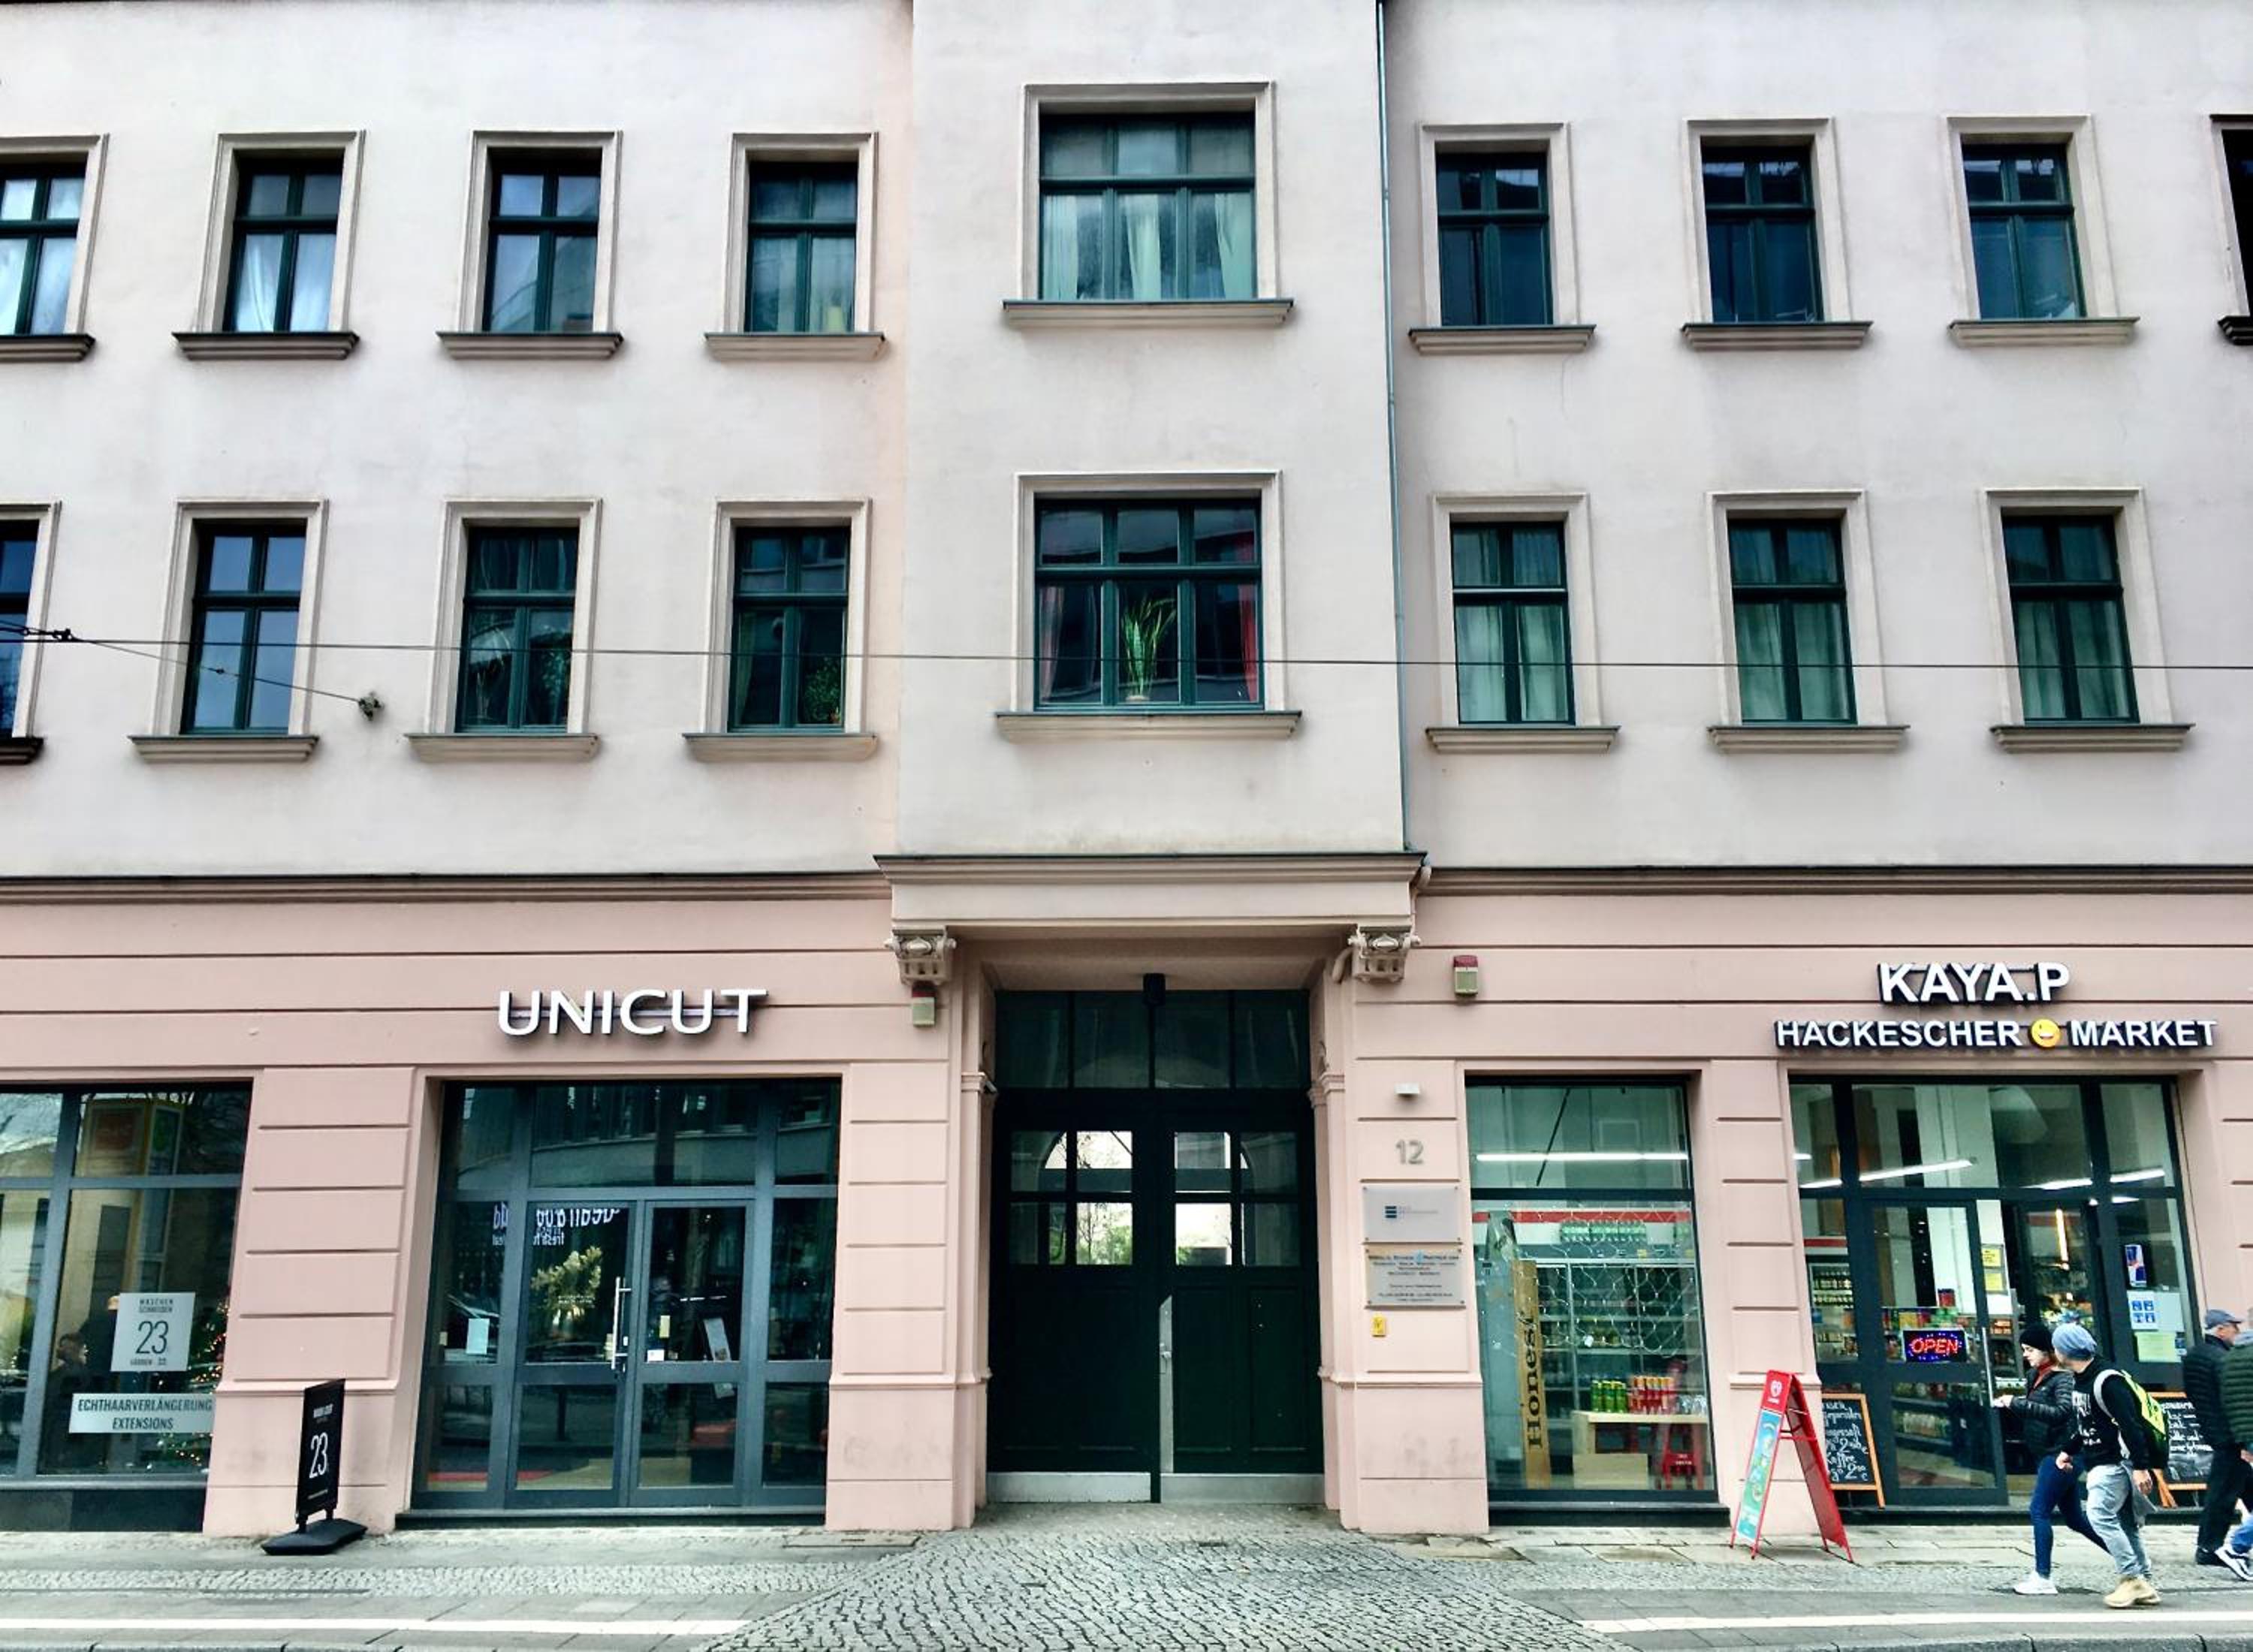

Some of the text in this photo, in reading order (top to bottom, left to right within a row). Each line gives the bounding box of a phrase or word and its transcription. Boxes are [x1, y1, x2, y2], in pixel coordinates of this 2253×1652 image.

[1878, 961, 2070, 1004] KAYA.P
[498, 987, 768, 1036] UNICUT
[1775, 1019, 2218, 1048] HACKESCHER MARKET
[1395, 1138, 1425, 1165] 12
[135, 1320, 169, 1355] 23
[1910, 1337, 1958, 1355] OPEN
[77, 1396, 213, 1412] ECHTHAARVERLÄNGERUNG
[112, 1417, 173, 1430] EXTENSIONS
[309, 1431, 328, 1479] 23
